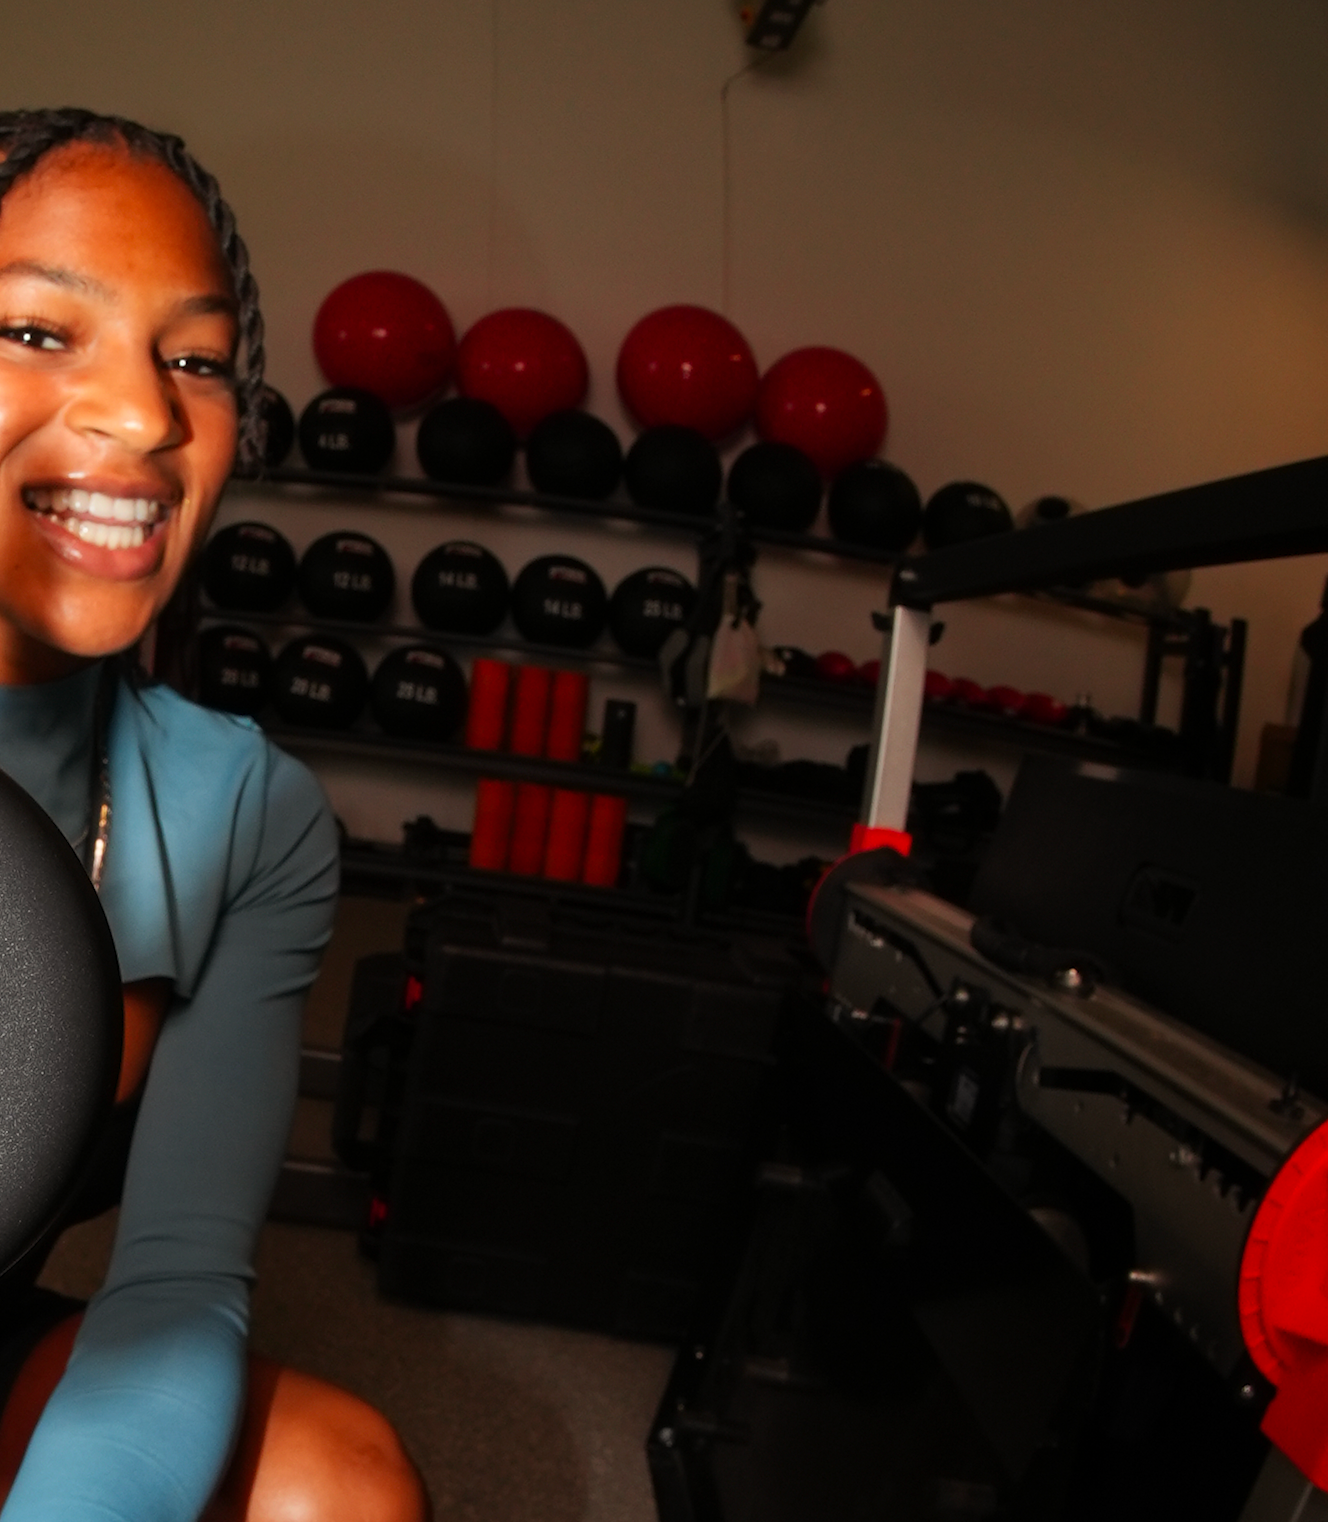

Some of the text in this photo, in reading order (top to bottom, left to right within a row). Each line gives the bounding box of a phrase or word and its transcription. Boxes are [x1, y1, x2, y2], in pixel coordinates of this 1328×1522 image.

[333, 571, 351, 589] 12
[439, 571, 455, 587] 14
[543, 598, 561, 615] 14
